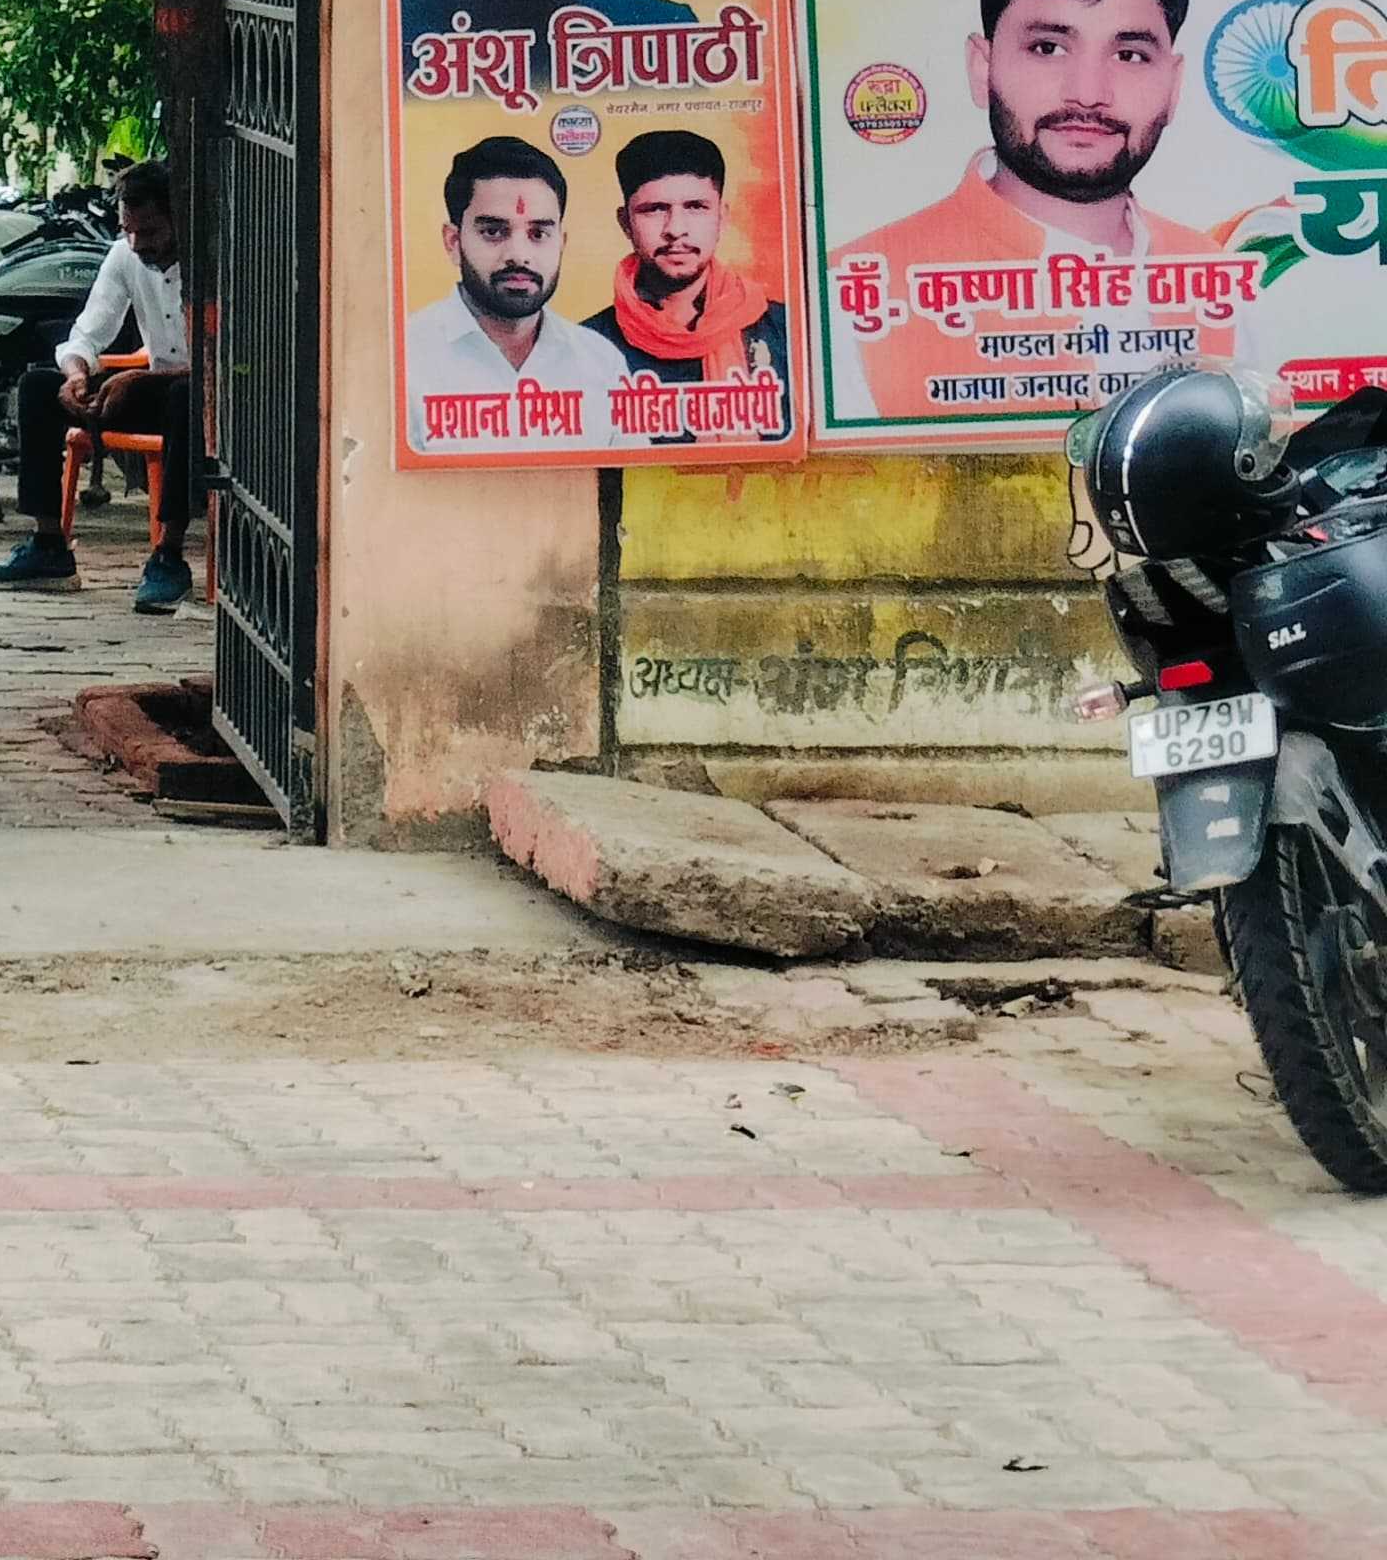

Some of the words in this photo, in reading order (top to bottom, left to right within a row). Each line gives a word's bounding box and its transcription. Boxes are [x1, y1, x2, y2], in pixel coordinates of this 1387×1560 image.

[412, 15, 537, 111] अंशू
[552, 5, 764, 91] त्रिपाठी
[914, 266, 1039, 329] कृष्णा
[1047, 253, 1137, 311] सिंह
[1144, 258, 1259, 320] ठाकुर
[979, 330, 1055, 358] मण्डल
[1064, 323, 1109, 355] मंत्री
[423, 392, 511, 441] प्रशान्त
[516, 378, 584, 437] मिश्रा
[607, 374, 679, 434] मोहित
[682, 370, 782, 432] बाजपेयी
[928, 375, 1006, 402] भाजपा
[1015, 372, 1090, 399] जनपद
[1268, 621, 1307, 651] TVS
[1165, 730, 1247, 768] 6290
